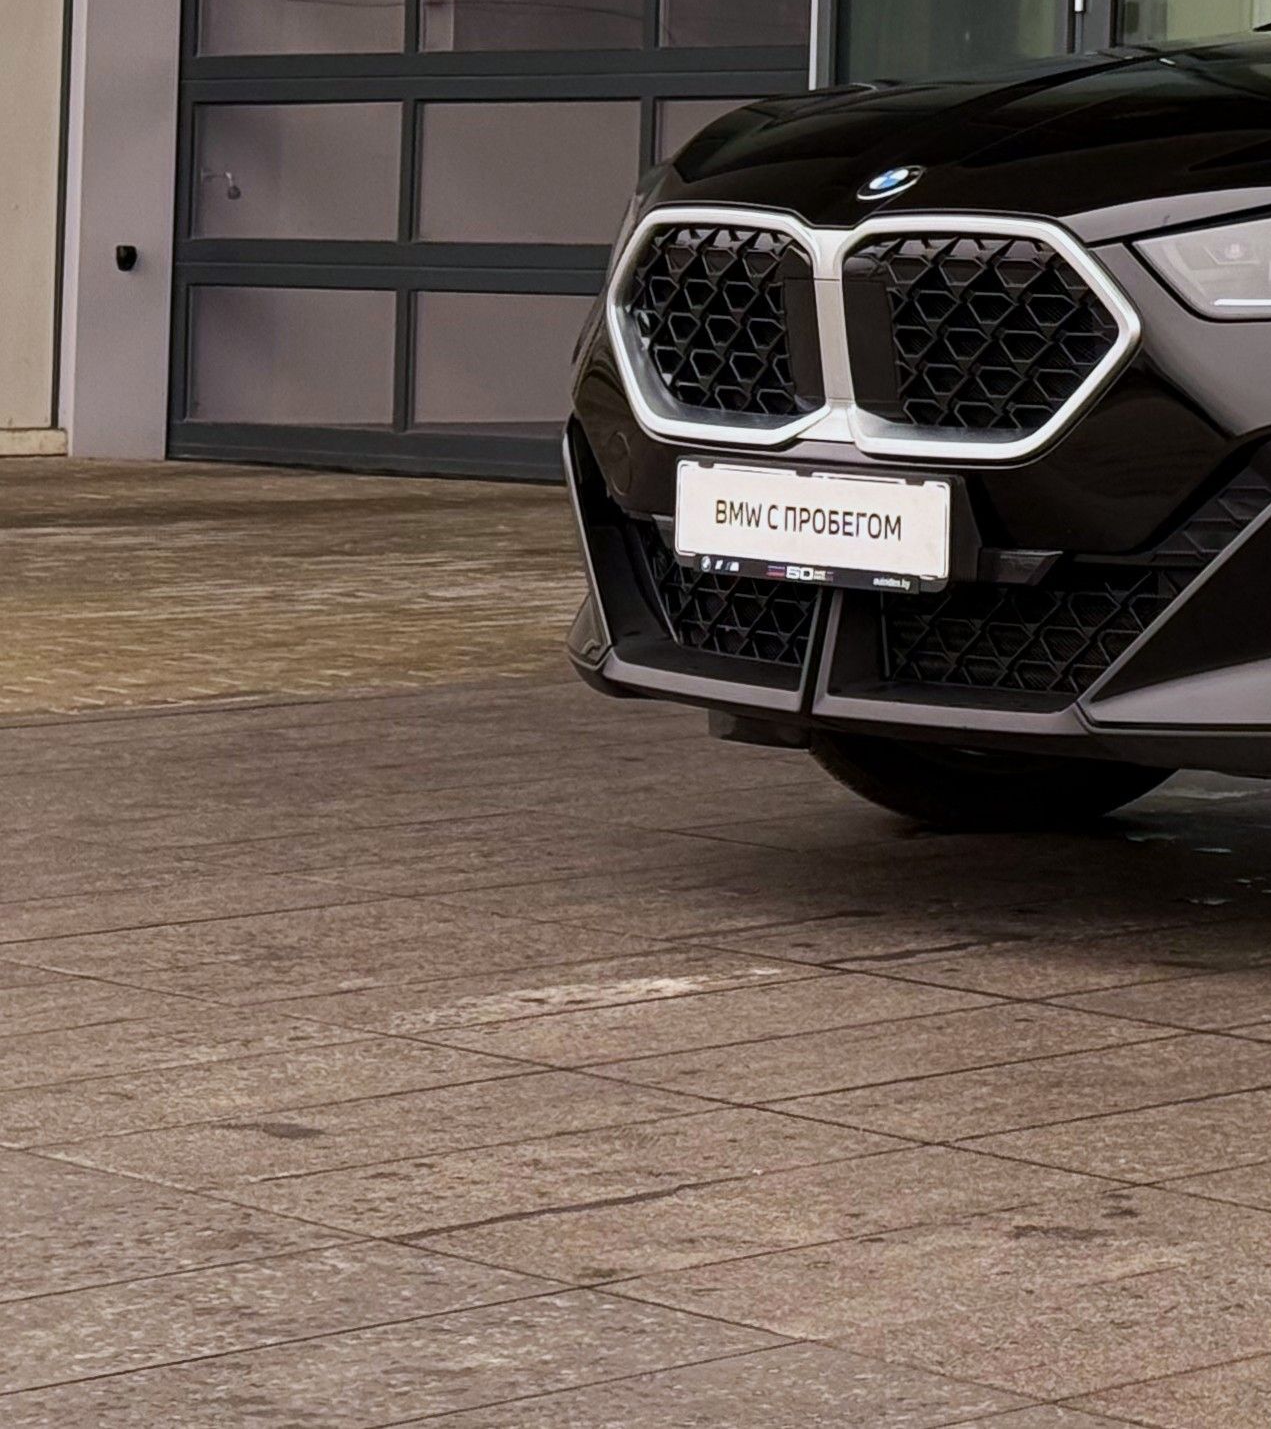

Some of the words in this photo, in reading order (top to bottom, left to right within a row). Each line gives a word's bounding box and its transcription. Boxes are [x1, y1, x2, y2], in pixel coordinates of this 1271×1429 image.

[715, 499, 762, 528] BMW
[767, 504, 779, 530] С
[784, 506, 902, 541] ПРОБЕГОМ
